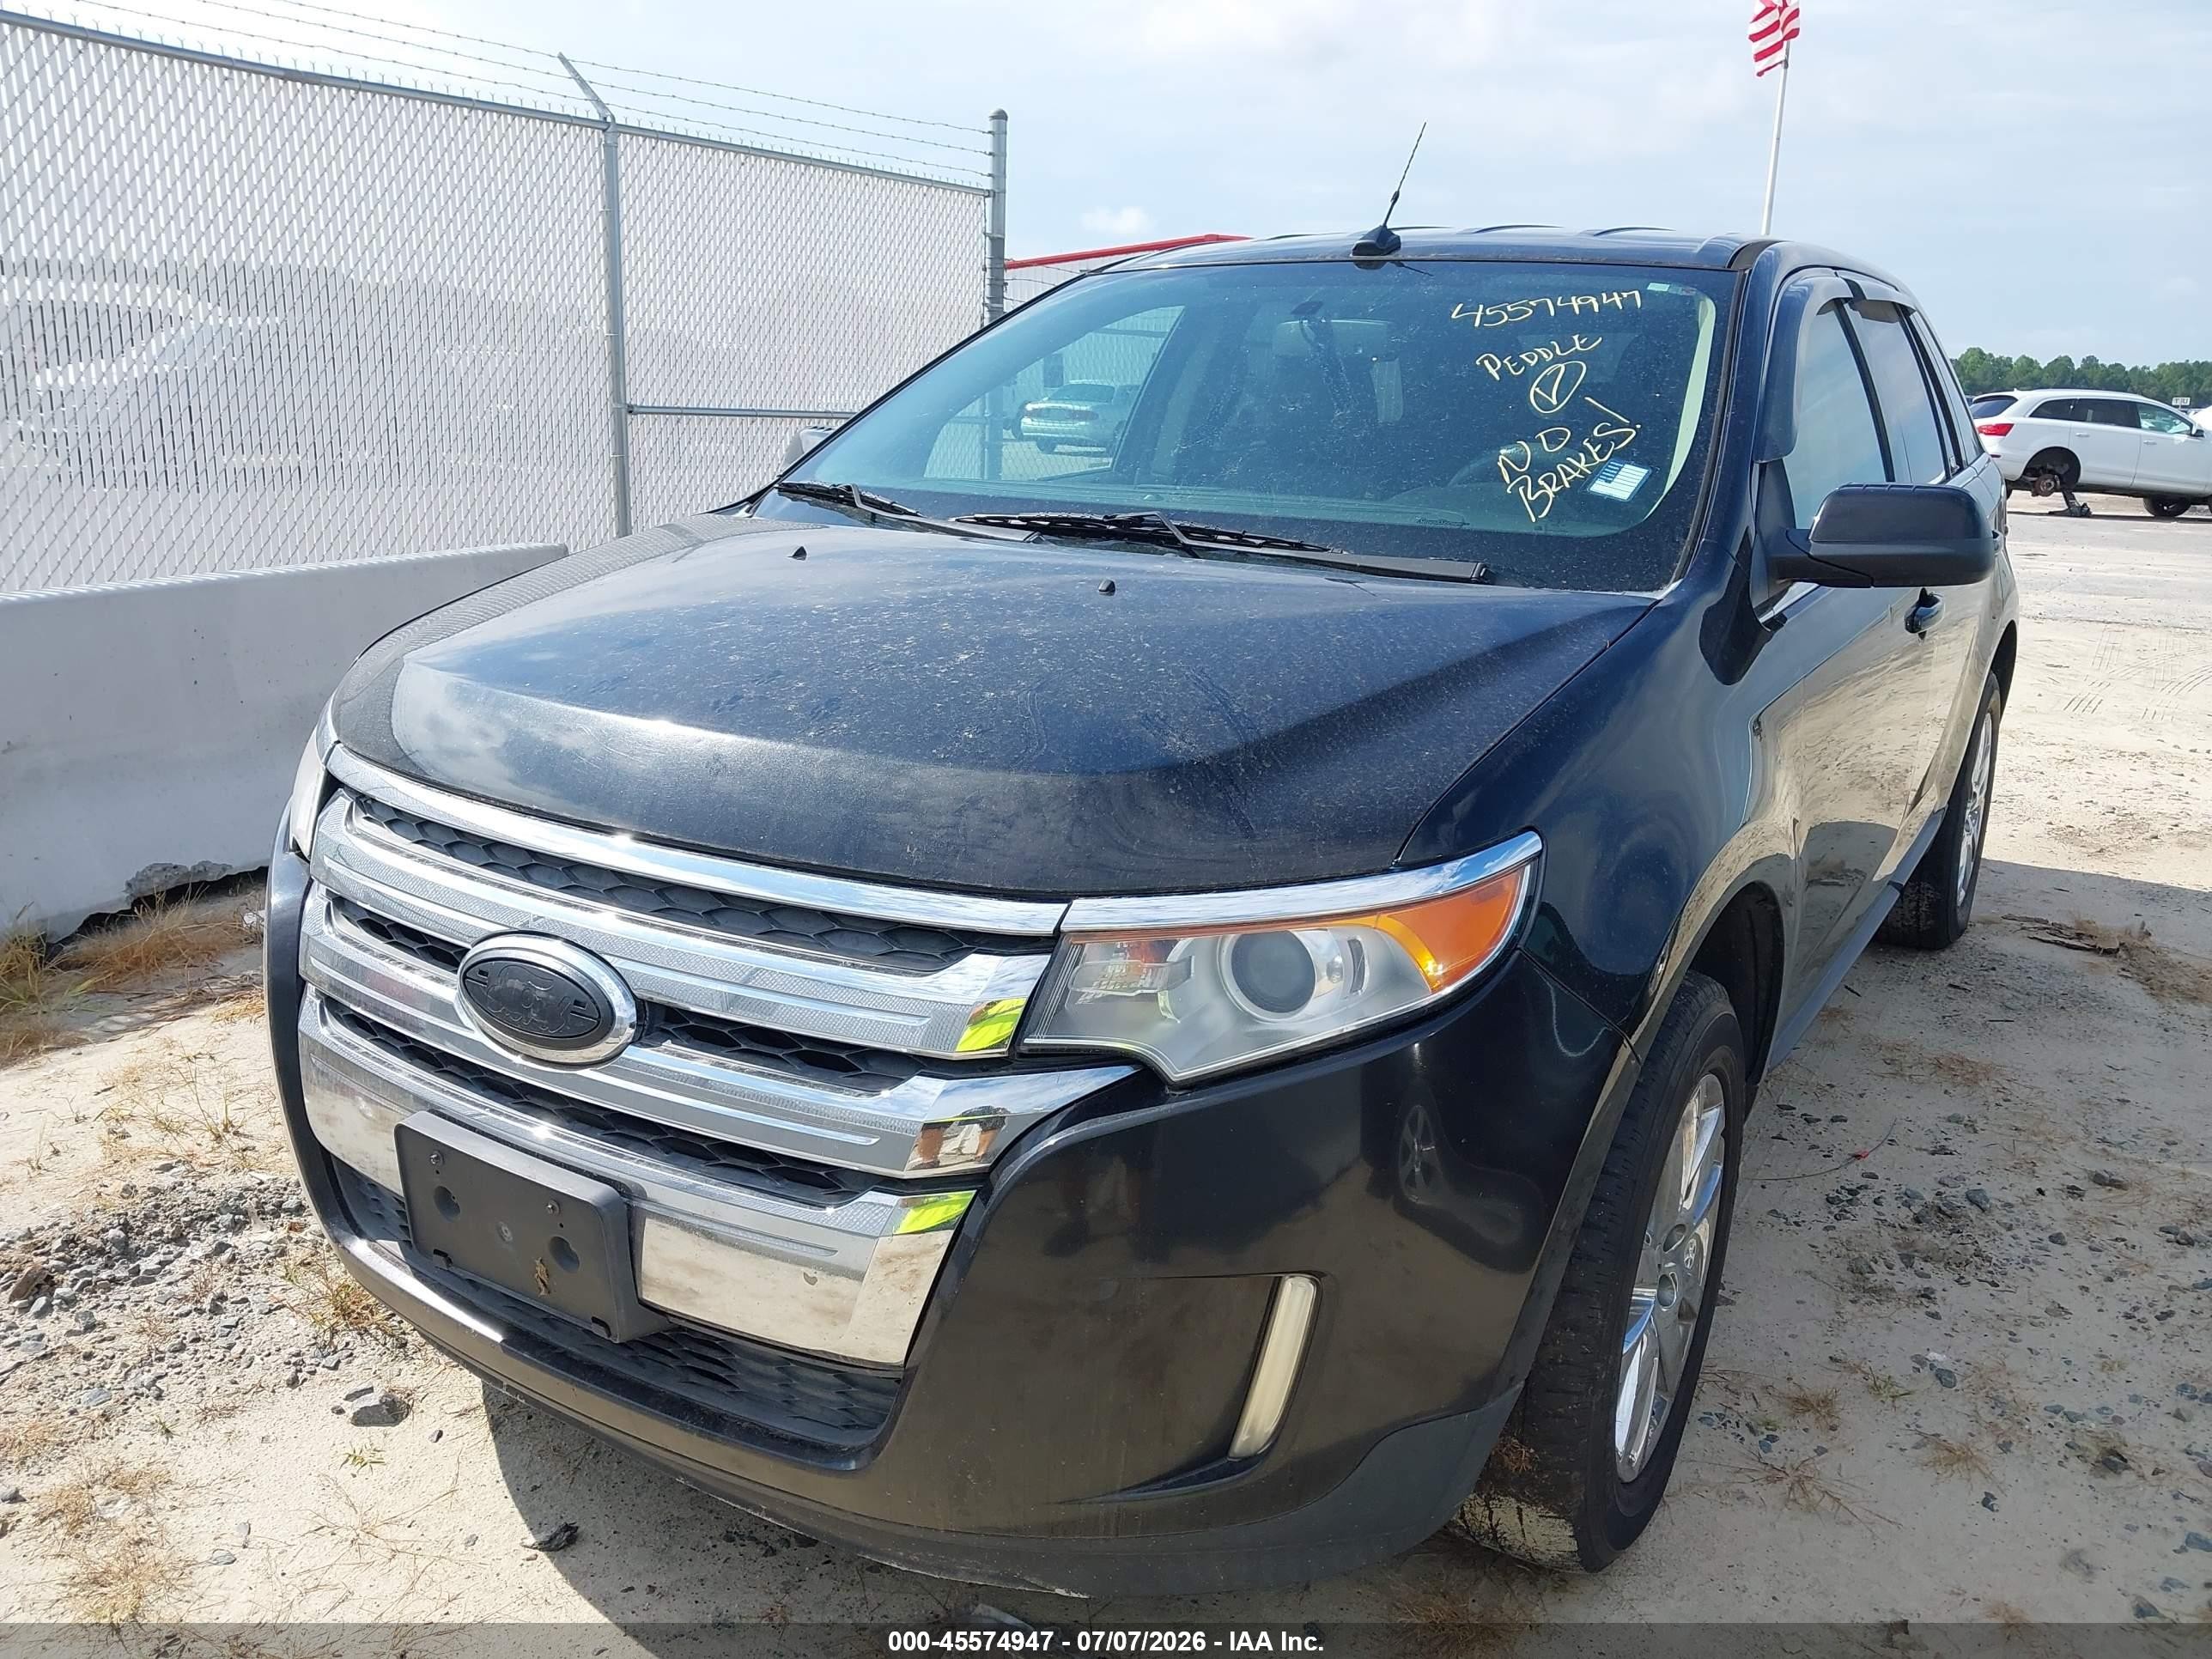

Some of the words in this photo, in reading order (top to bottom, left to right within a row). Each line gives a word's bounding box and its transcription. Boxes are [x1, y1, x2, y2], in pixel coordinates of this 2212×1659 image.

[1450, 289, 1642, 327] 45574947
[1475, 334, 1603, 380] PEDDLE
[1498, 427, 1571, 483] NO
